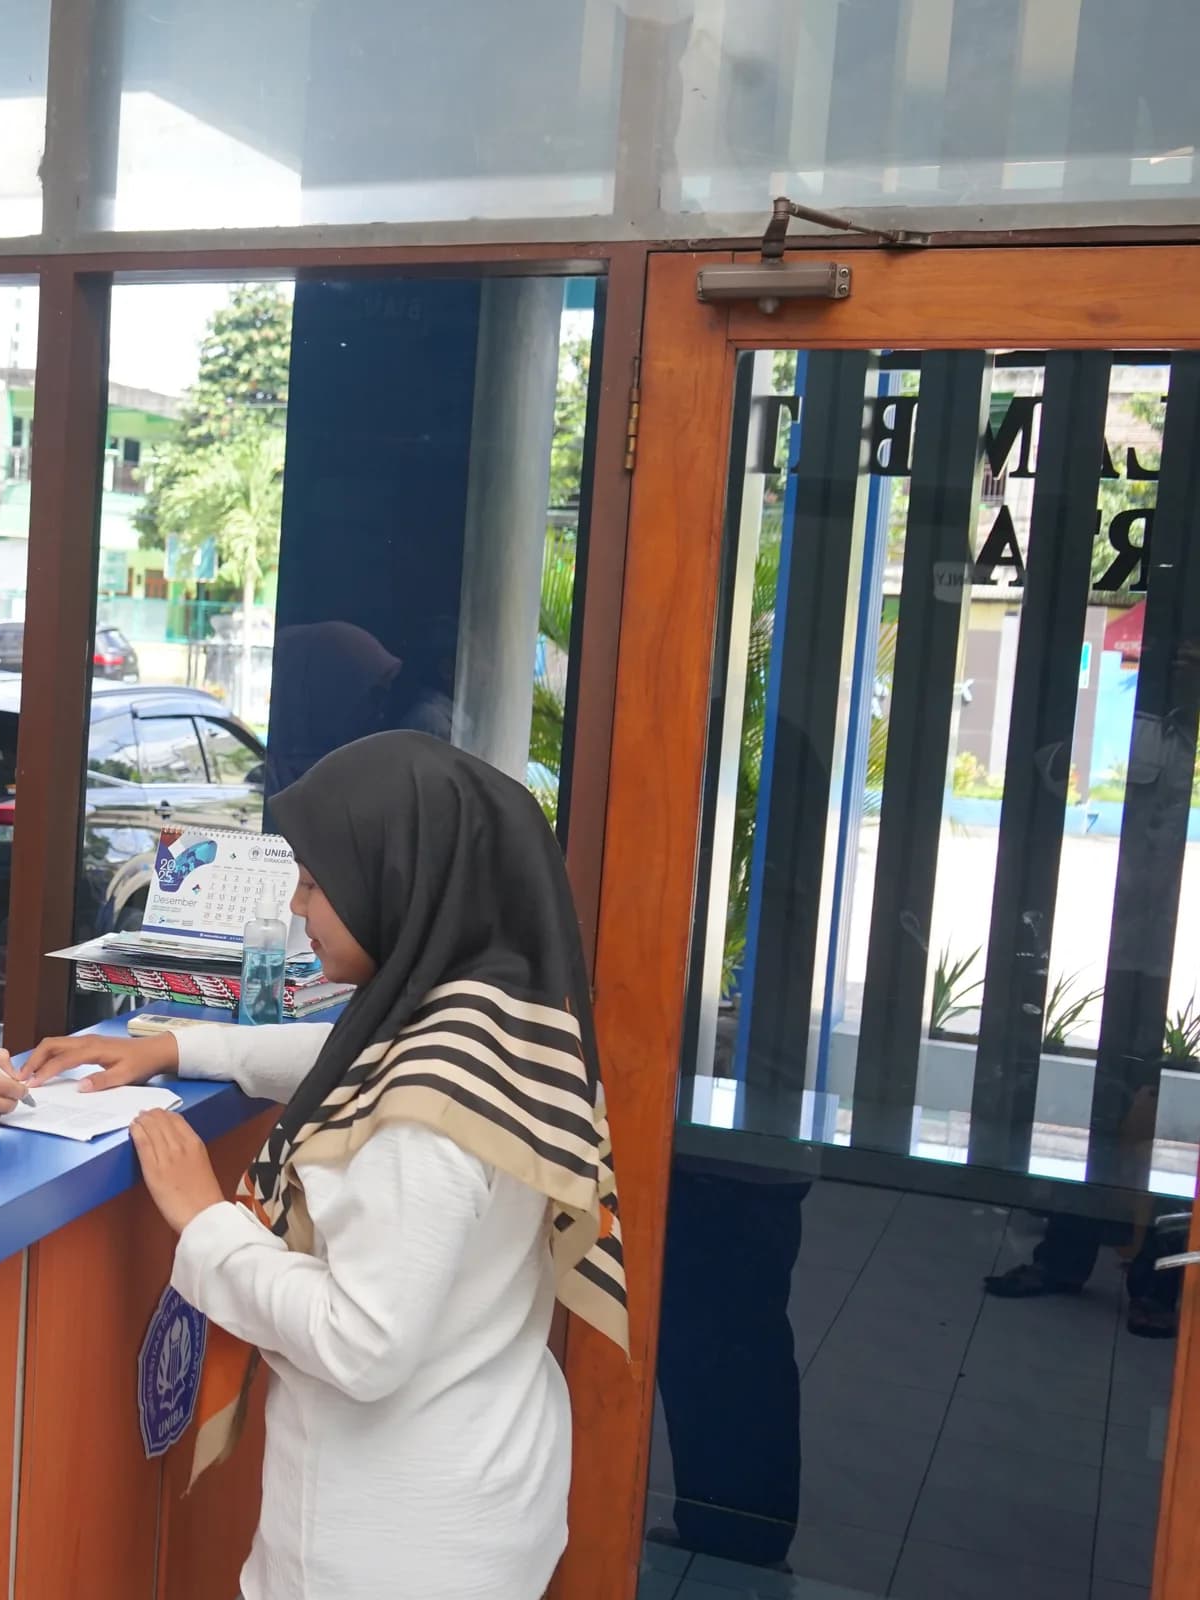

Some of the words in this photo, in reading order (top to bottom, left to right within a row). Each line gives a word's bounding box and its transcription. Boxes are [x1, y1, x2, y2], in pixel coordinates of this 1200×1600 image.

[264, 848, 293, 858] UNIBA
[160, 858, 176, 871] 20
[158, 870, 173, 881] 25
[153, 894, 198, 907] Desember
[157, 1406, 184, 1438] UNIBA
